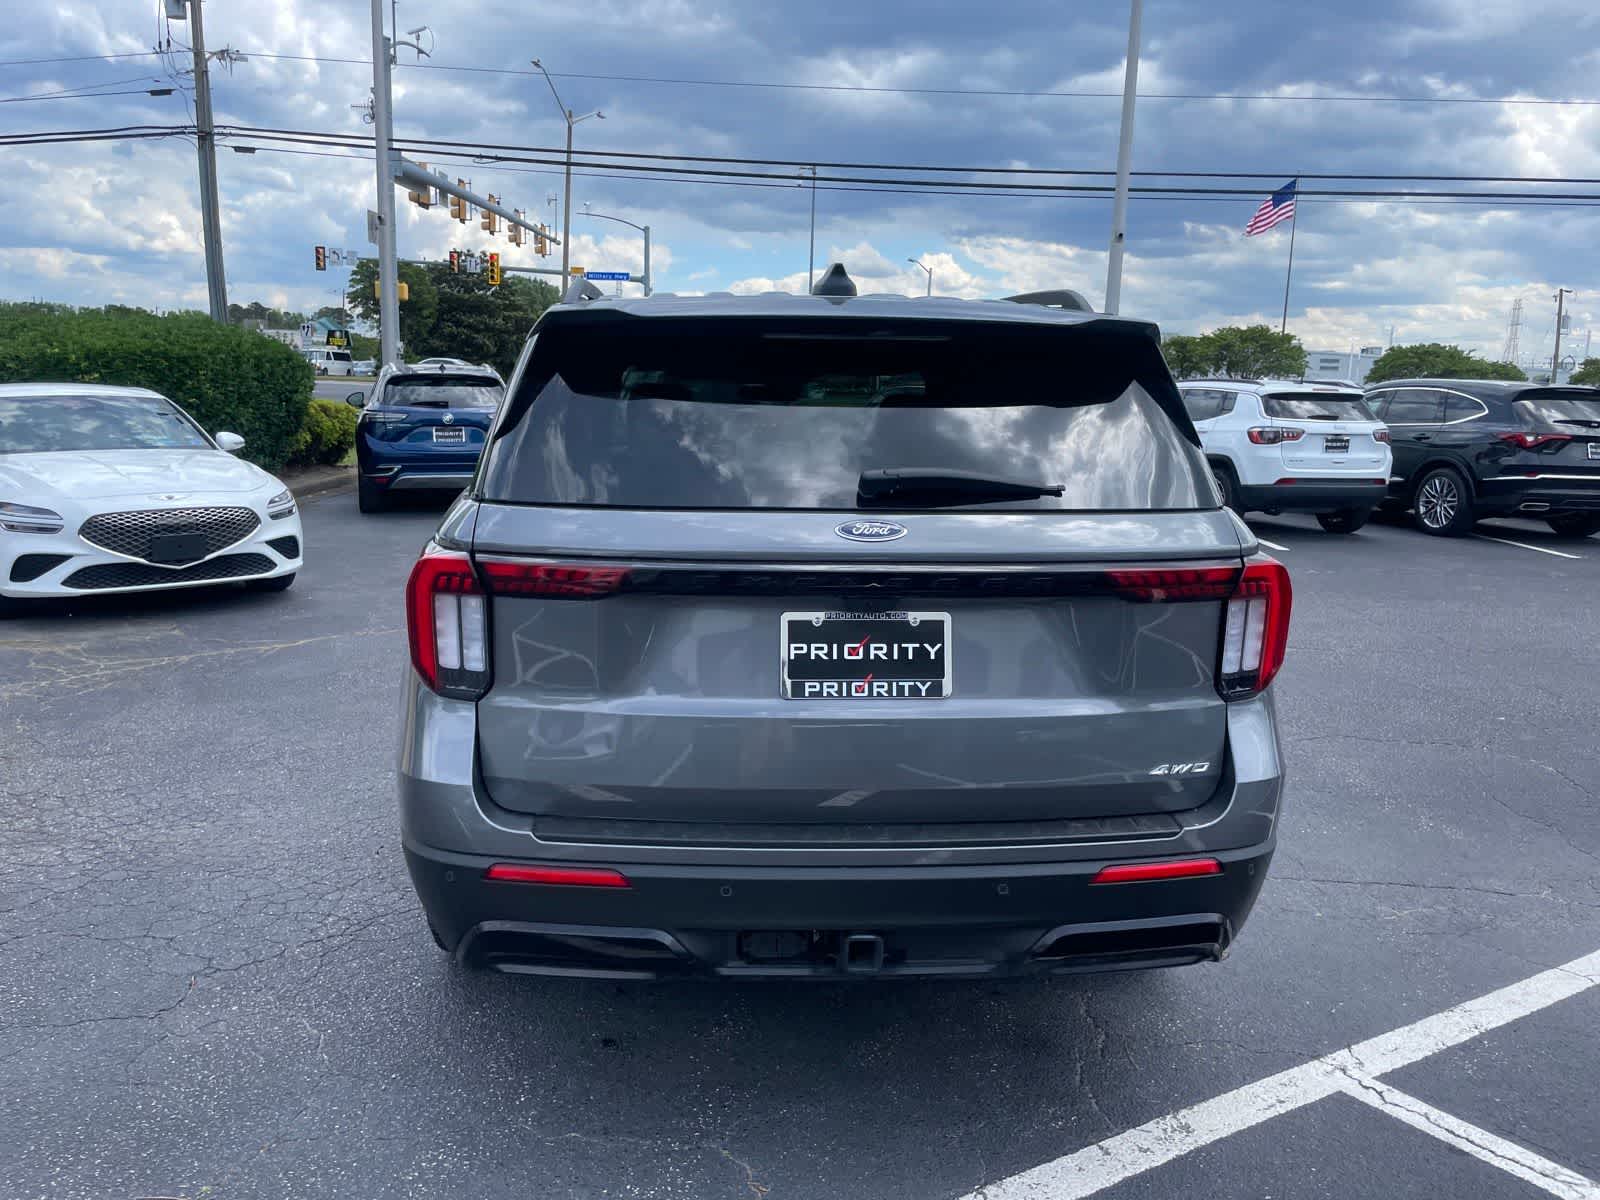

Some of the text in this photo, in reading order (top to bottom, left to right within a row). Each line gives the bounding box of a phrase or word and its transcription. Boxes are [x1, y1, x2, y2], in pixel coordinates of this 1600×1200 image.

[852, 522, 890, 535] Ford
[789, 642, 942, 660] PRIORITY
[804, 681, 933, 697] PRIORITY
[1149, 762, 1210, 775] 4WD
